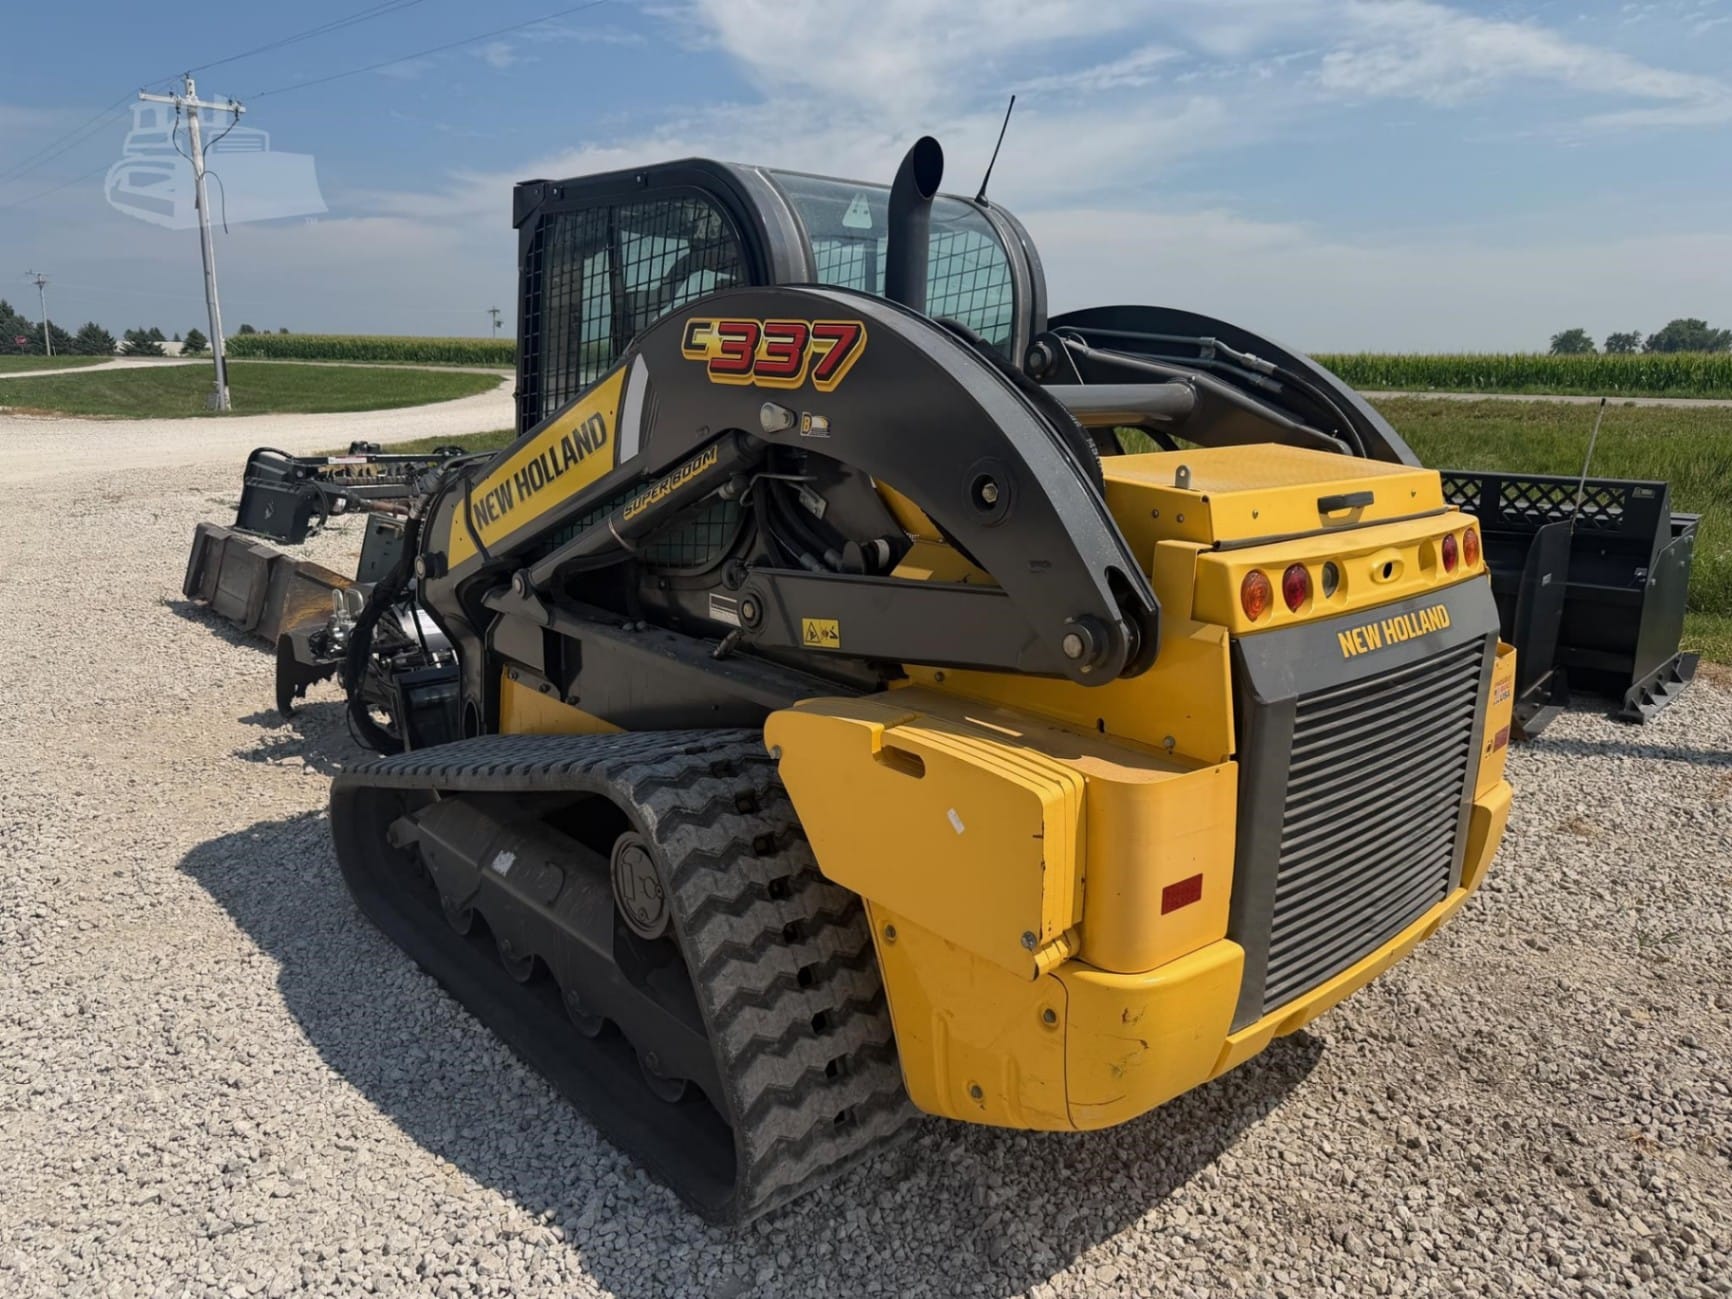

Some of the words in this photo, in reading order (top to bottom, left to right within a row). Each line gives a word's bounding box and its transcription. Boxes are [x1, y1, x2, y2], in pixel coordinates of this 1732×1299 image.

[682, 318, 867, 392] C337
[473, 478, 514, 530] NEW
[513, 411, 607, 502] HOLLAND
[624, 476, 671, 520] SUPER
[670, 444, 718, 490] BOOM
[1337, 623, 1382, 658] NEW
[1381, 604, 1450, 645] HOLLAND
